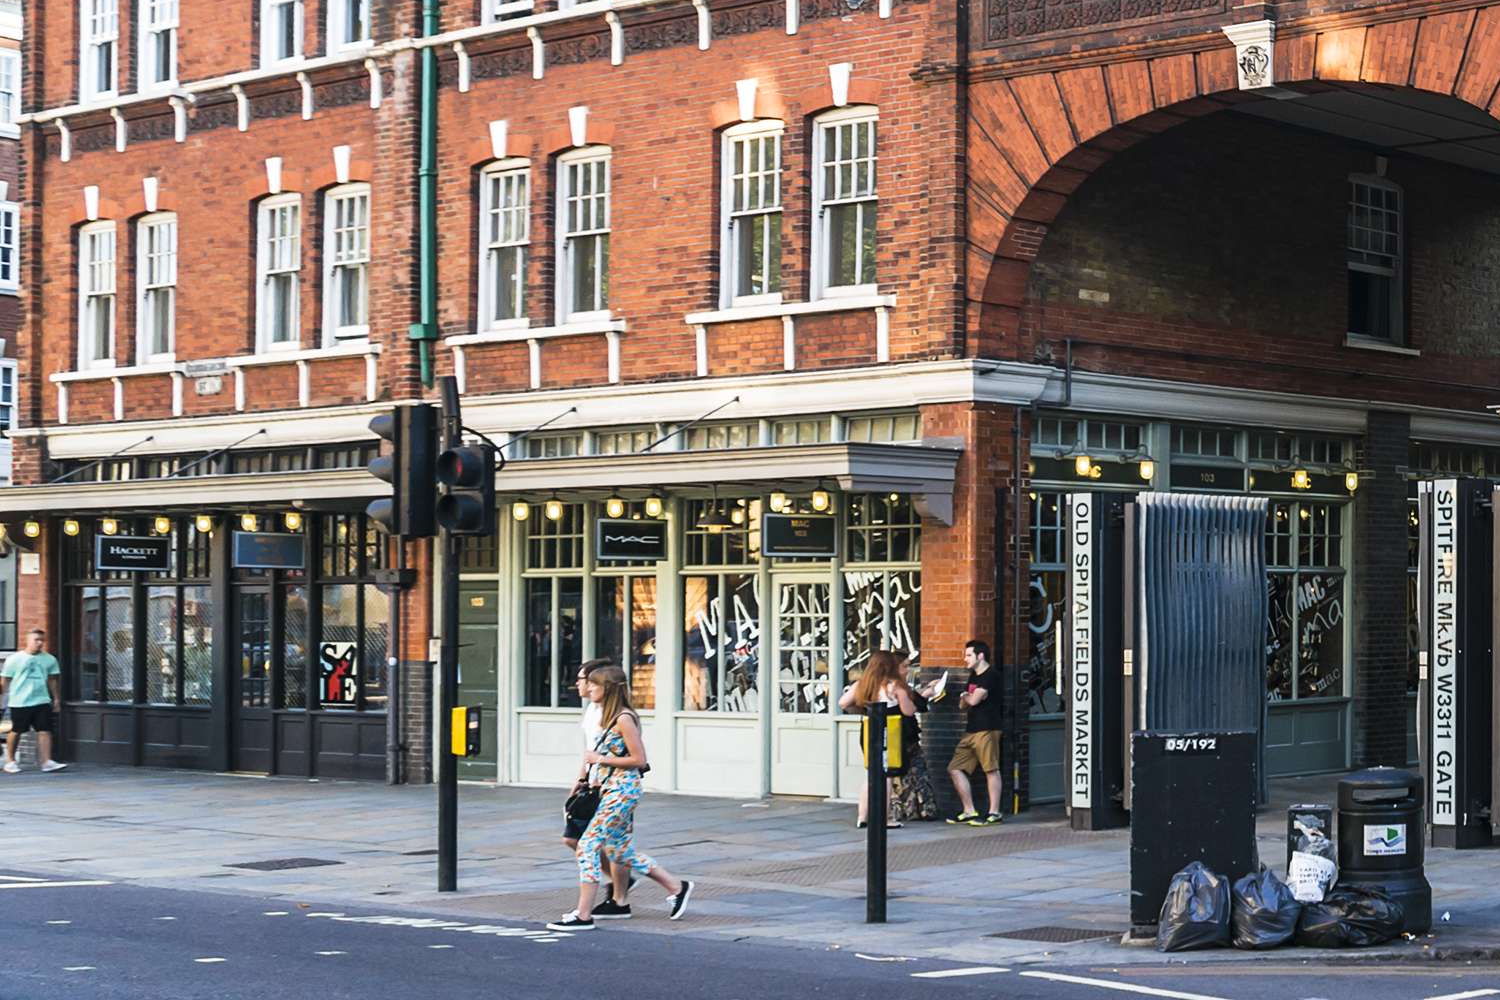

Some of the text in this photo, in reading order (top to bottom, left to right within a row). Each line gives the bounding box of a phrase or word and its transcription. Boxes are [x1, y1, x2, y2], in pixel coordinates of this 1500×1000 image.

[110, 546, 158, 555] HACKETT
[605, 535, 660, 544] MAC
[695, 574, 762, 660] MA
[1075, 502, 1089, 799] OLD SPITALFIELDS MARKET
[1437, 489, 1453, 815] SPITFIRE Mk.Vb W3311 GATE
[1166, 738, 1217, 751] 05/192
